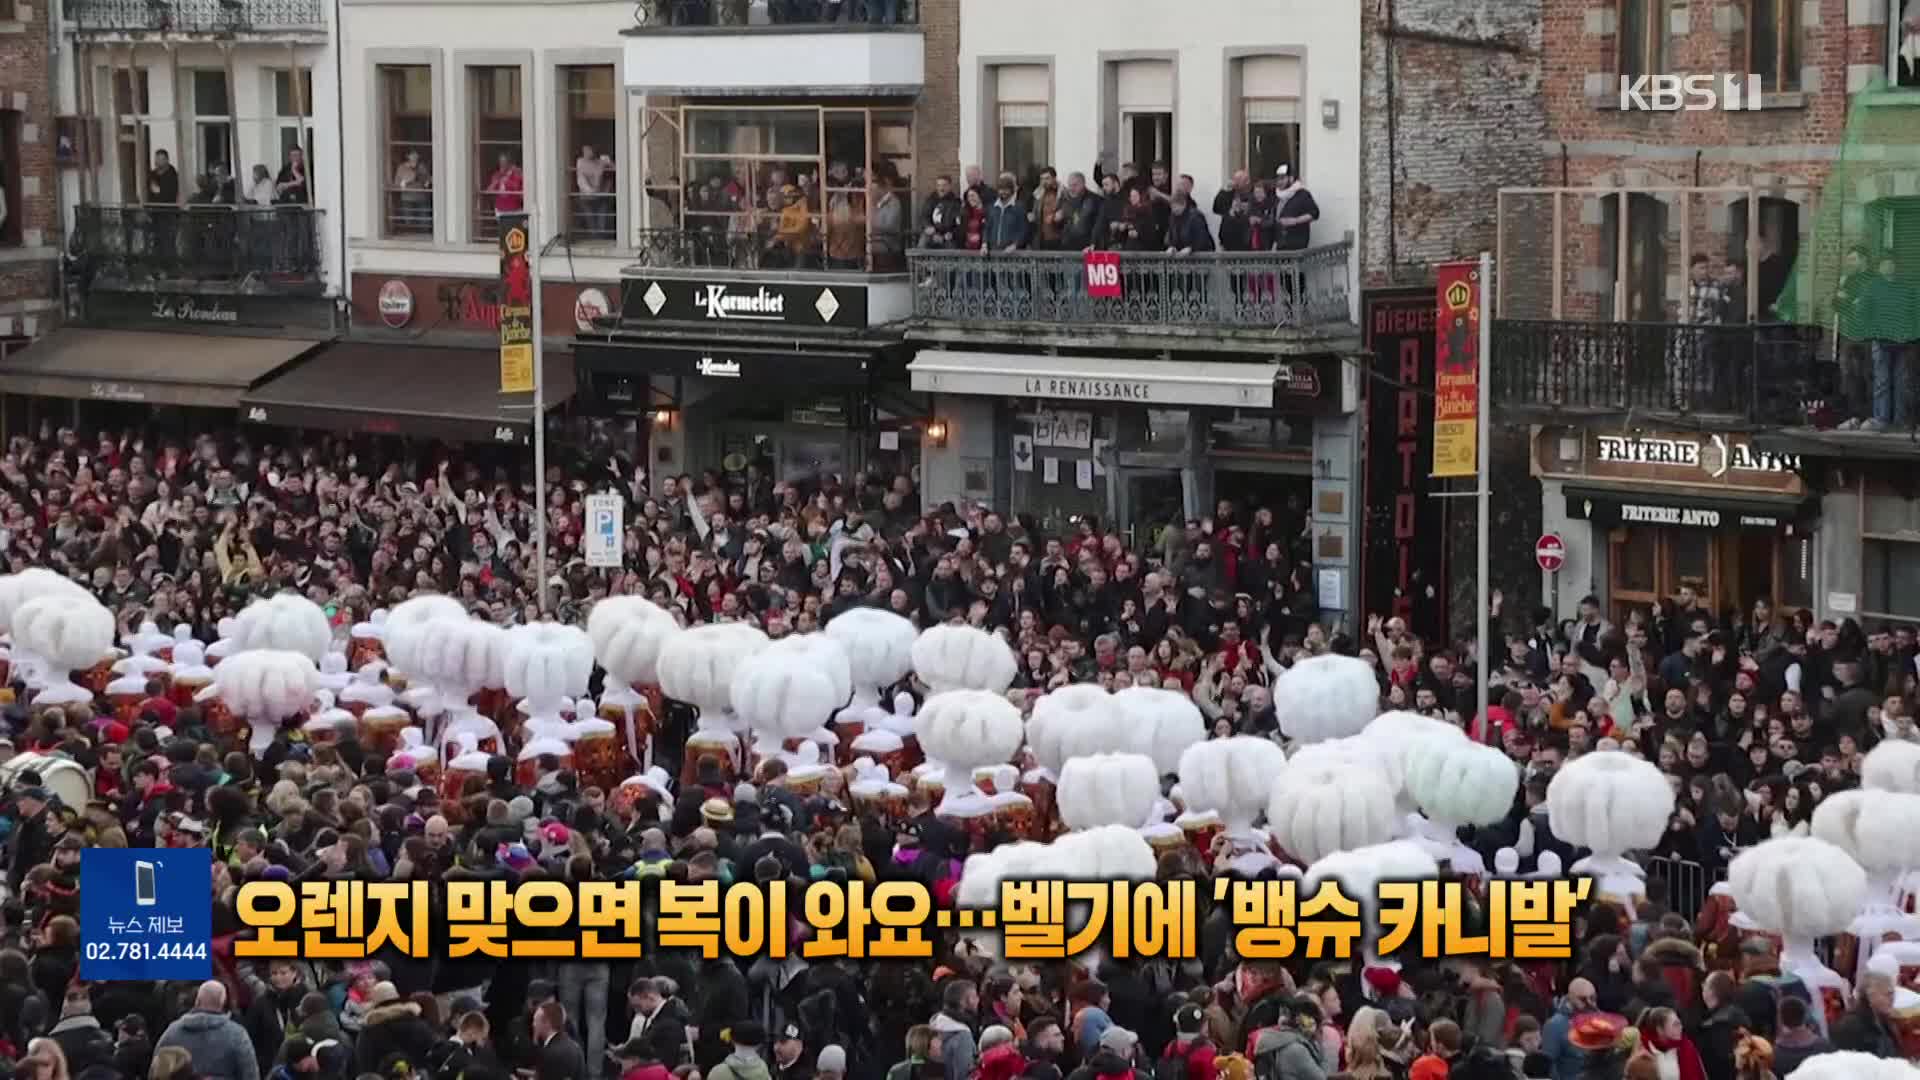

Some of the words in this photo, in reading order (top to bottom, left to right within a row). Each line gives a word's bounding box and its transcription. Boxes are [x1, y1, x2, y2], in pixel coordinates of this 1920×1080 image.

[1088, 263, 1118, 286] M9
[695, 291, 706, 306] Le
[706, 285, 785, 318] Karmeliet
[1025, 377, 1042, 393] LA
[1050, 379, 1150, 399] RENAISSANCE
[1036, 418, 1088, 441] BAR
[1598, 436, 1700, 466] FRITERIE
[1621, 503, 1680, 523] FRITERIE
[1682, 508, 1720, 527] ANTO
